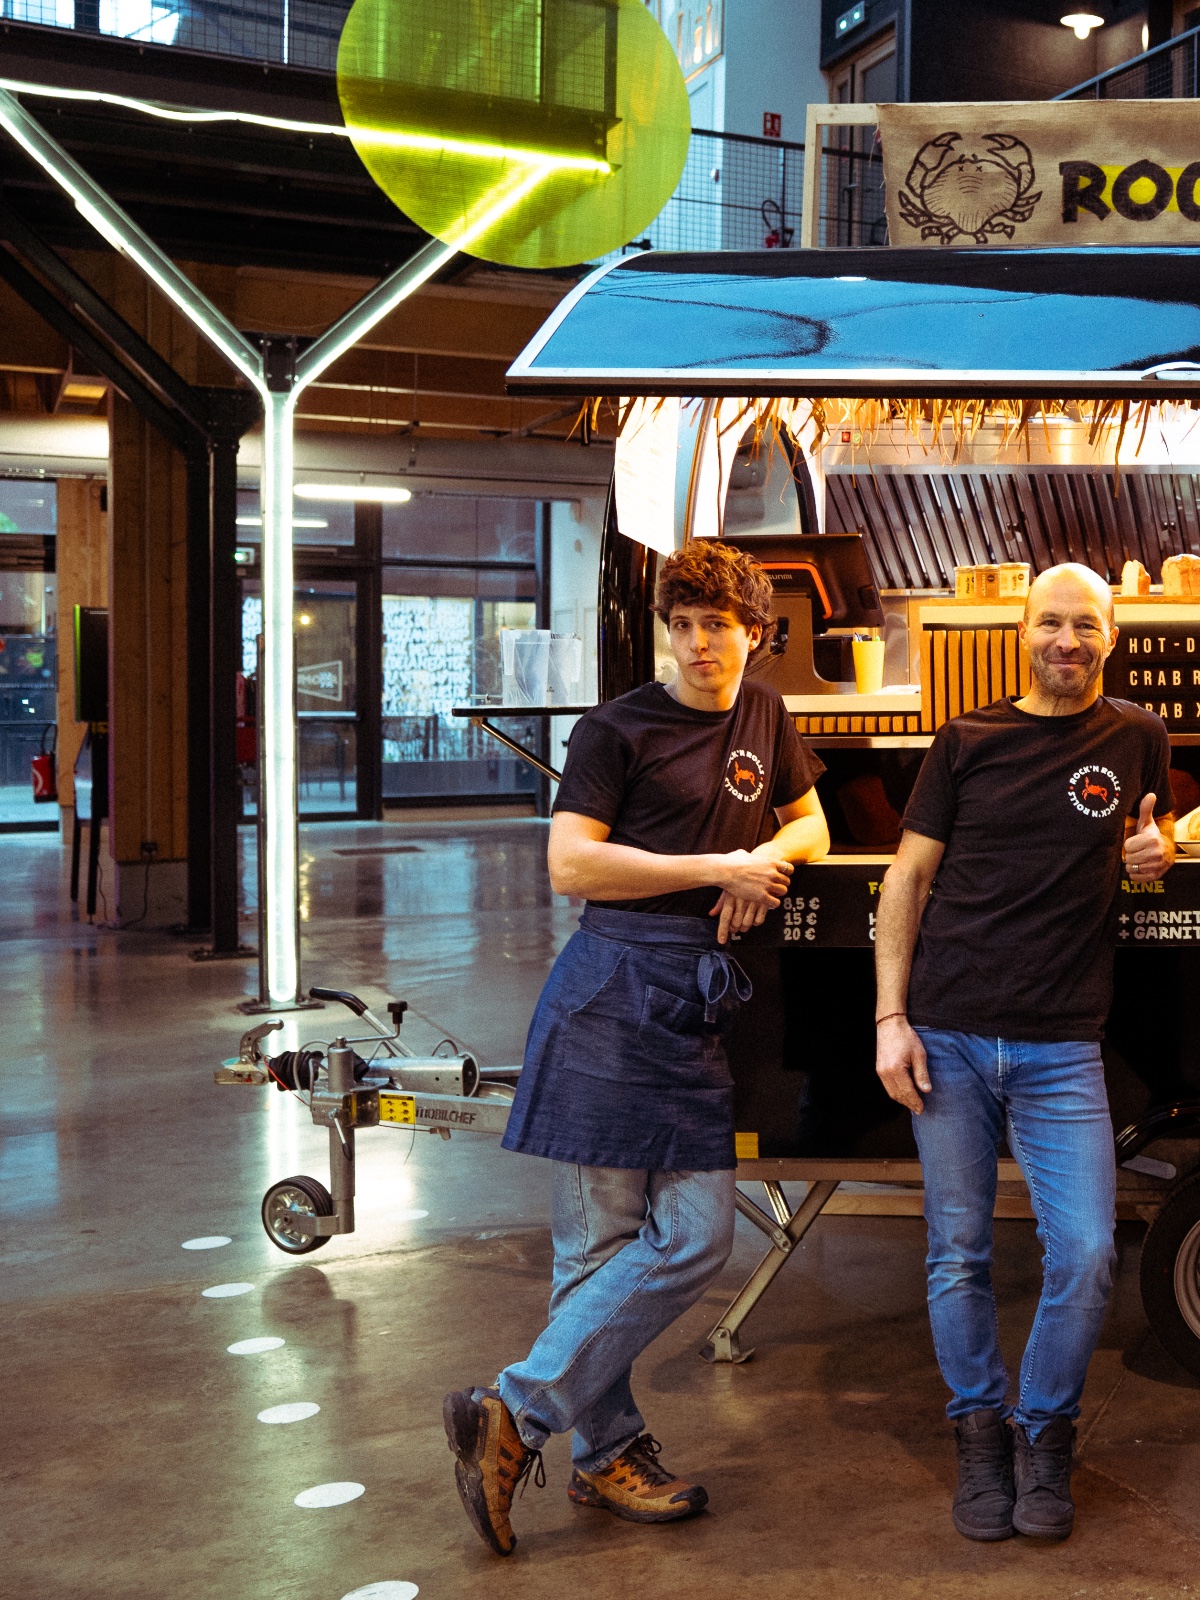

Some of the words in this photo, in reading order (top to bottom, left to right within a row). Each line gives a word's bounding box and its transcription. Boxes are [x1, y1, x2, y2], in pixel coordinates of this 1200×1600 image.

[1129, 670, 1182, 686] CRAB
[1144, 702, 1183, 719] RAB
[1069, 765, 1100, 785] ROCK'N
[1100, 766, 1121, 791] ROLLS
[1068, 791, 1091, 815] ROLLS
[1091, 797, 1119, 818] ROCK'N
[1121, 879, 1165, 894] AINE
[783, 897, 805, 911] 8,5
[809, 897, 820, 910] €
[784, 912, 802, 926] 15
[806, 912, 817, 926] €
[783, 927, 801, 941] 20
[804, 927, 816, 941] €
